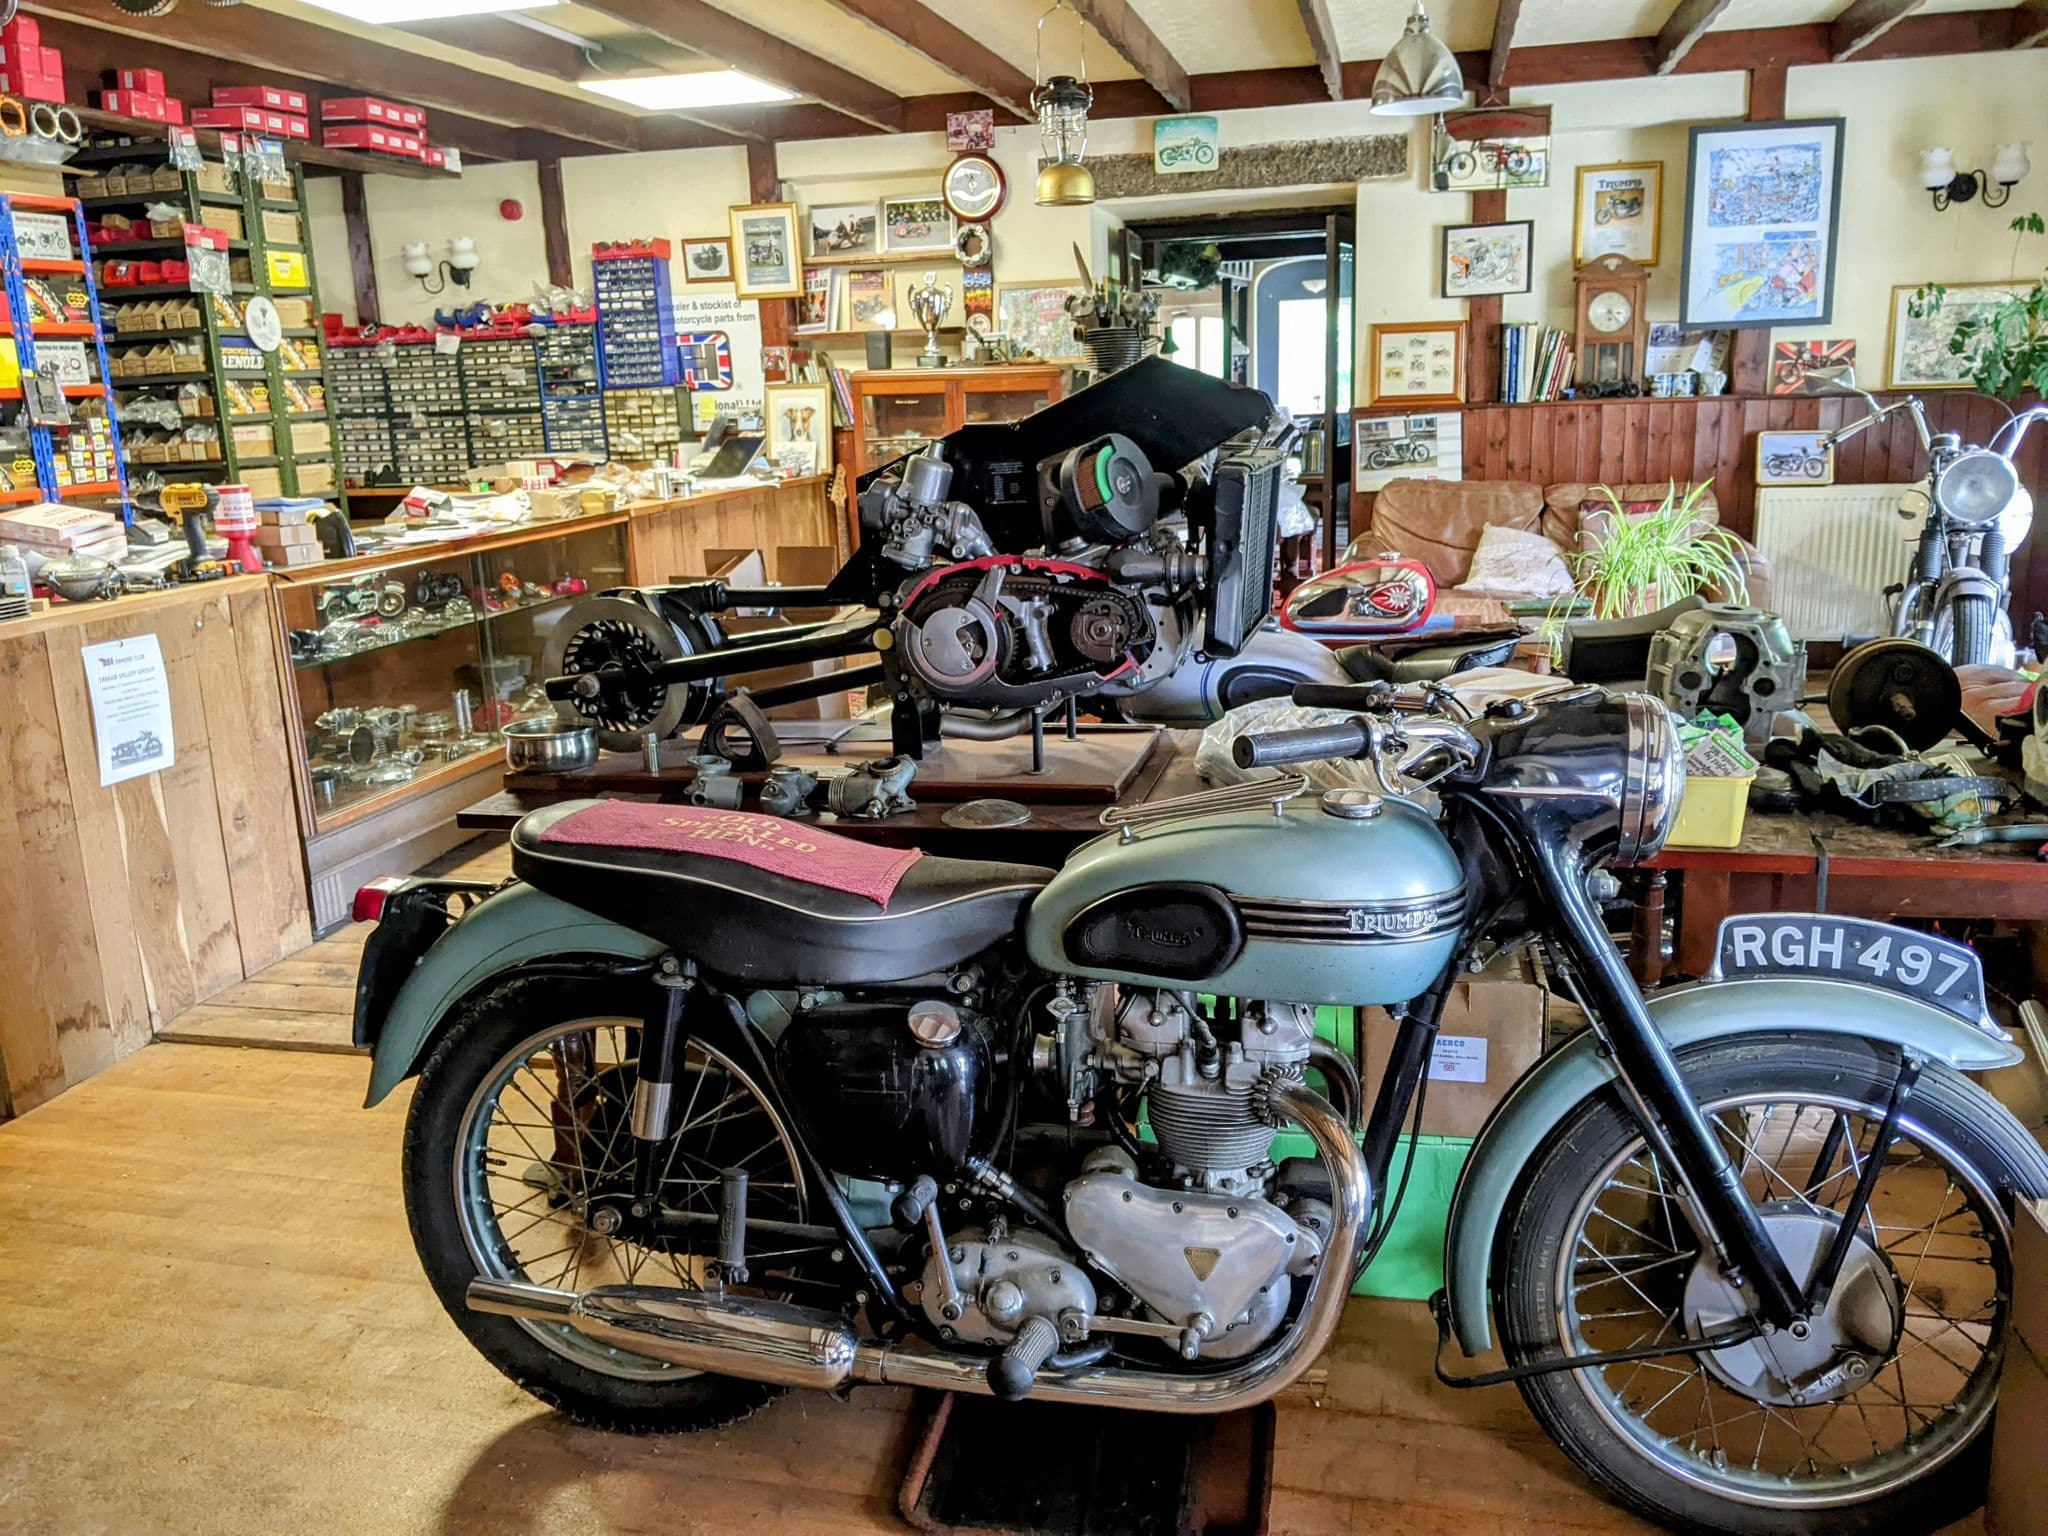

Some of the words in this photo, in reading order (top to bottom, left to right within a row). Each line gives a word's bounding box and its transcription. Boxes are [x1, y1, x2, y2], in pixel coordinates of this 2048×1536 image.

[1598, 179, 1642, 188] TRIUMPH
[700, 300, 732, 310] stockist
[714, 313, 735, 324] parts
[737, 312, 756, 322] from
[658, 817, 817, 853] SPECKLED
[1345, 908, 1440, 936] TRIUMPH
[1732, 925, 1845, 971] RGH
[1856, 935, 1971, 997] 497
